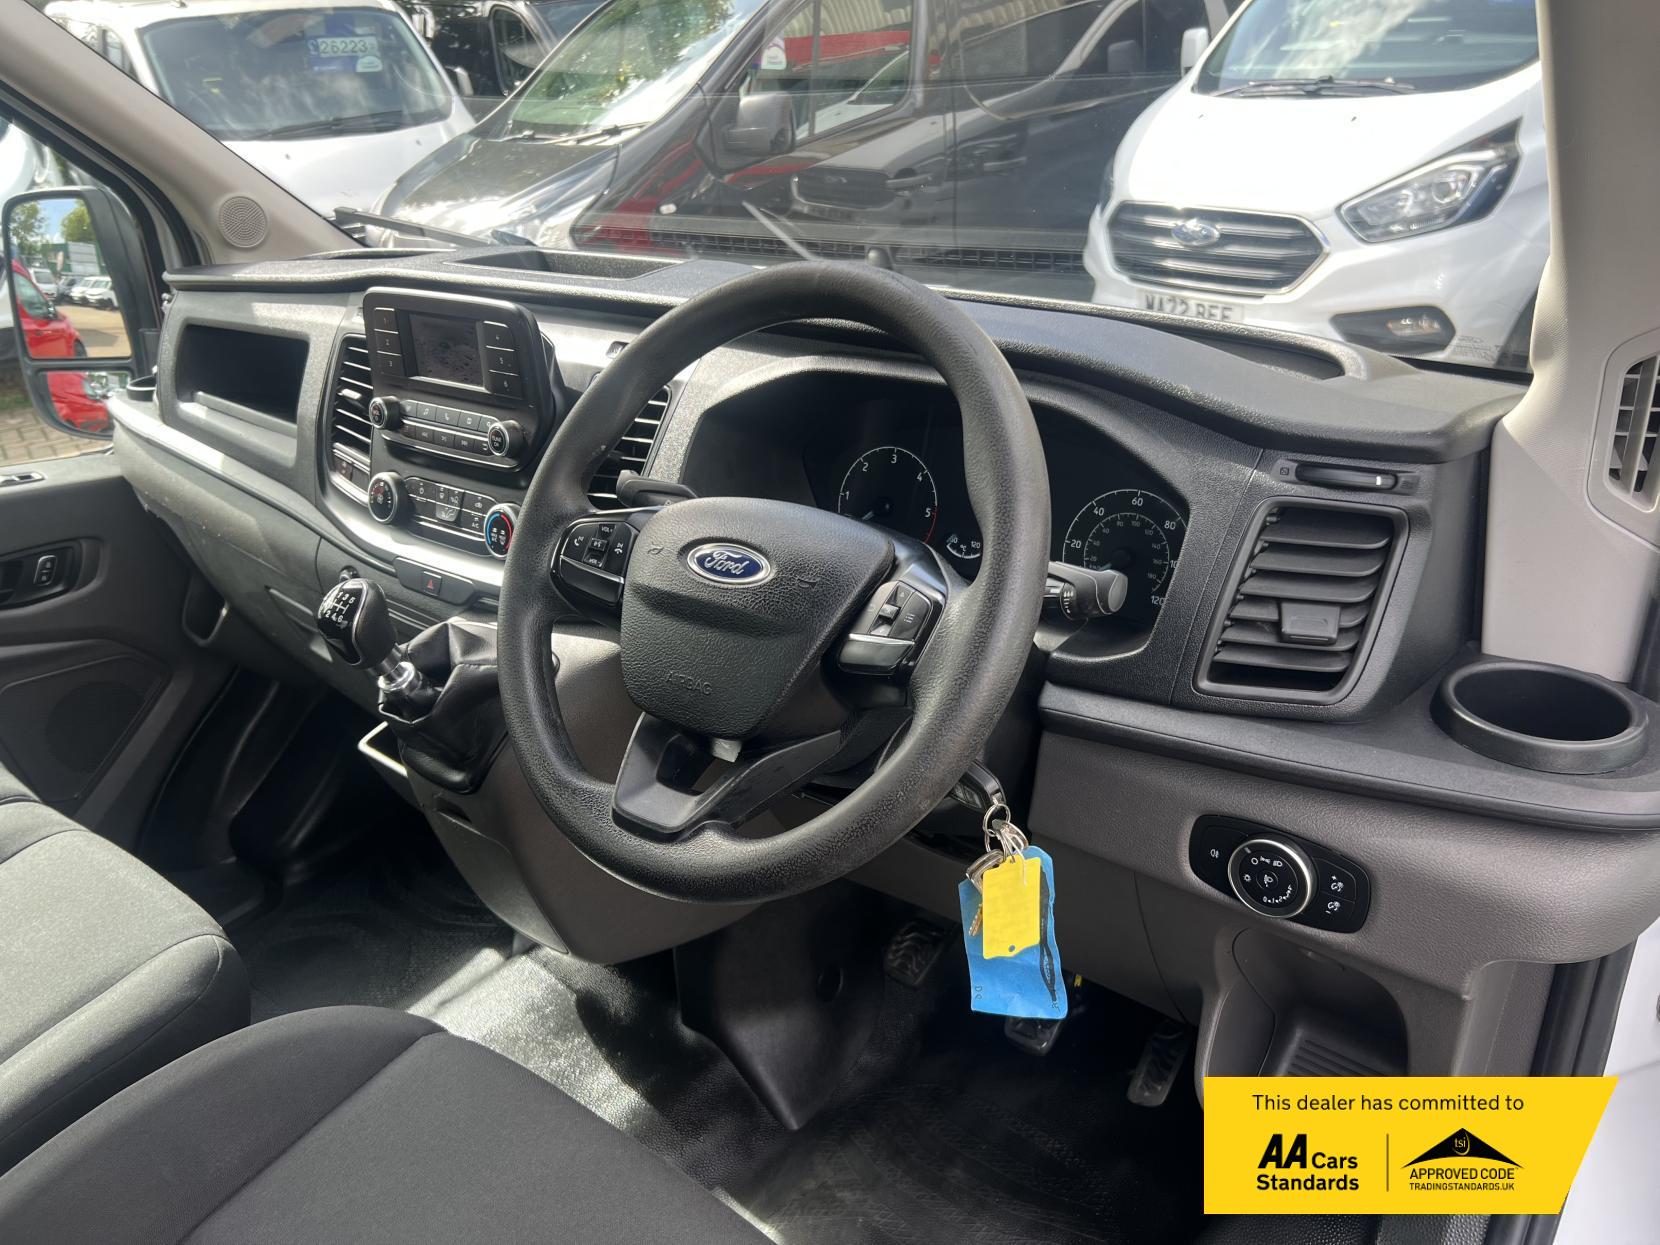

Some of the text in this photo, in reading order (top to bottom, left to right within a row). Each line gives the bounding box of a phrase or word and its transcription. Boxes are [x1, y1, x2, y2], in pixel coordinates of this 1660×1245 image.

[891, 454, 898, 464] 3
[862, 462, 869, 472] 2
[916, 472, 923, 482] 4
[844, 491, 851, 500] 1
[1131, 498, 1144, 507] 60
[925, 508, 932, 518] 5
[1093, 507, 1105, 516] 40
[1164, 520, 1176, 530] 80
[1070, 539, 1082, 549] 20
[704, 551, 750, 575] Ford
[1150, 595, 1166, 605] 120
